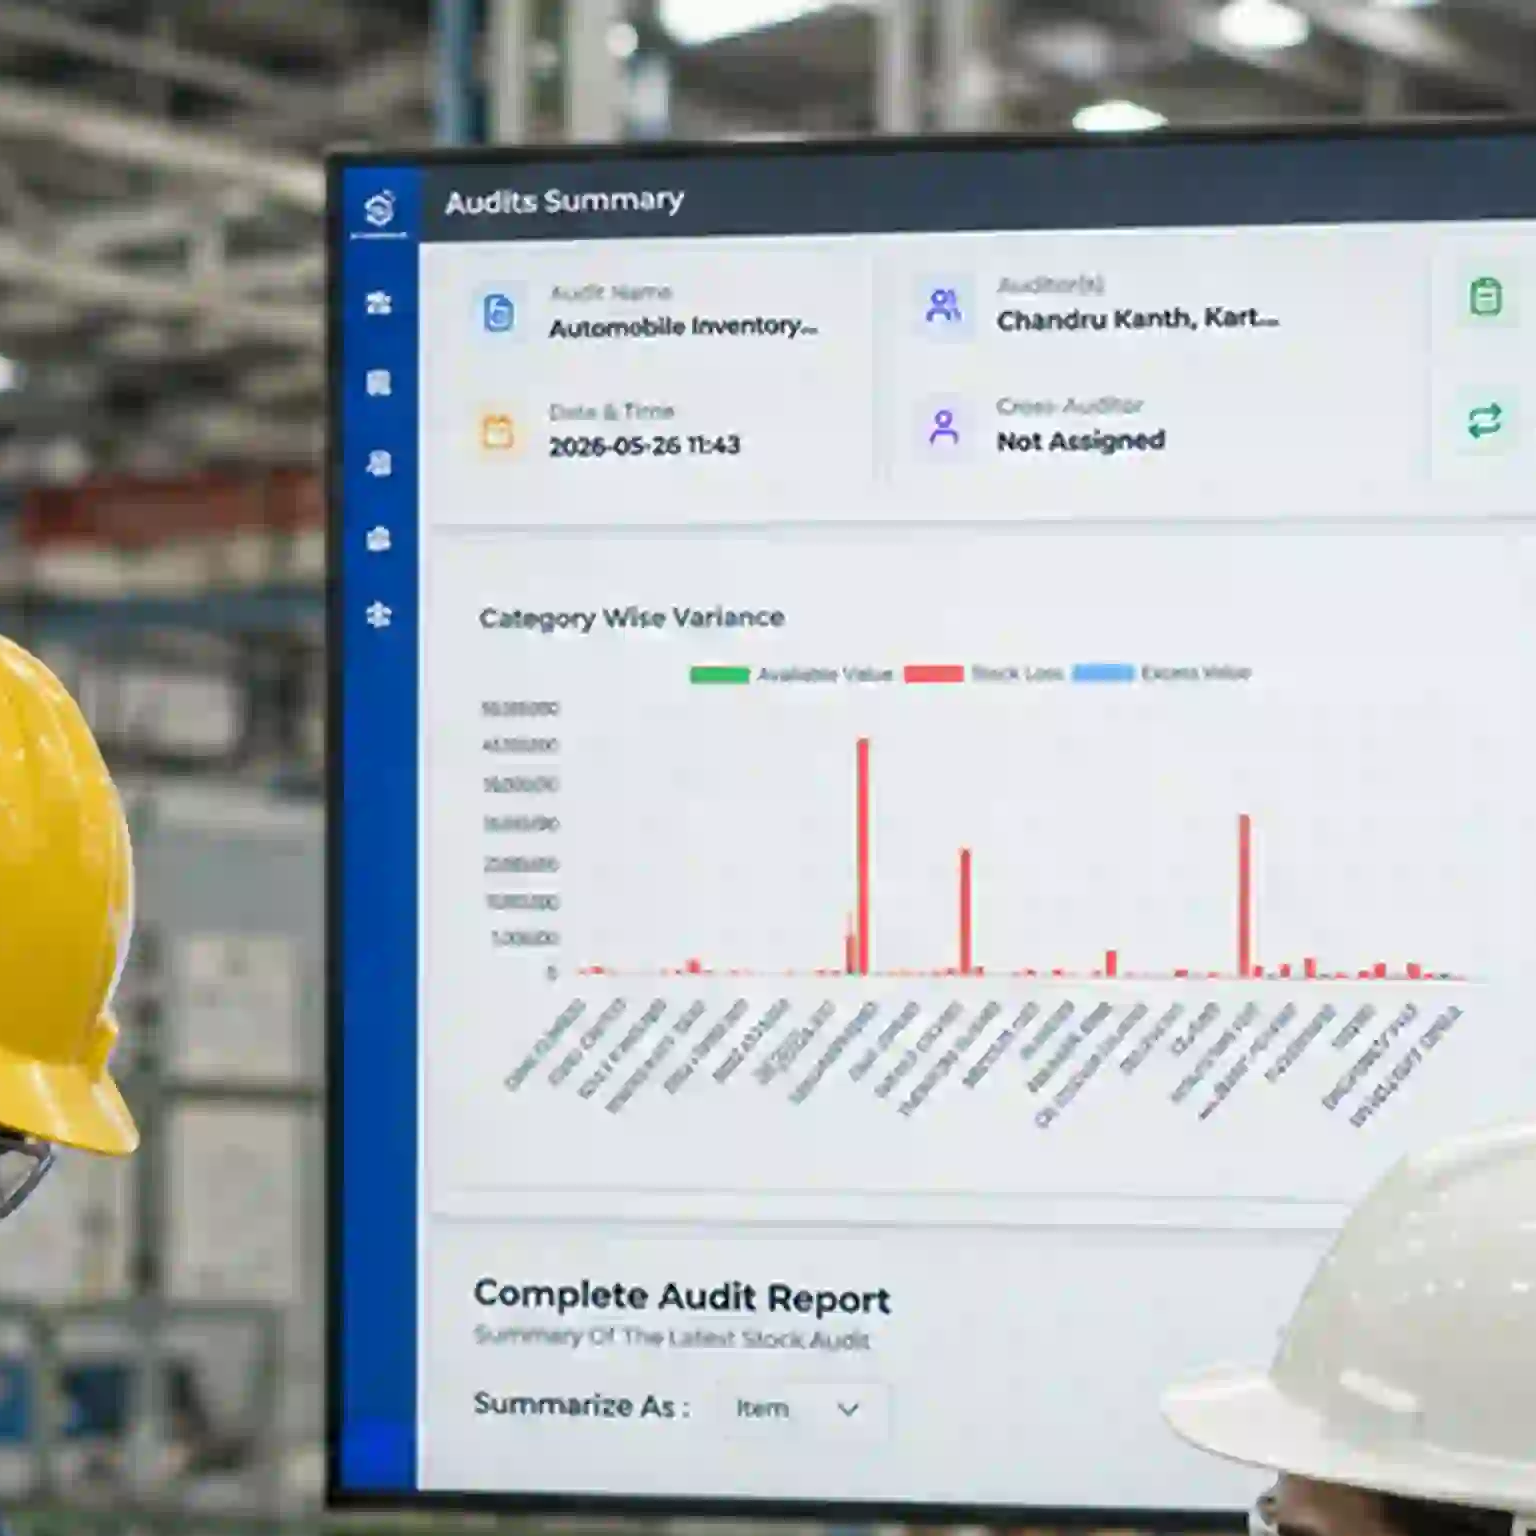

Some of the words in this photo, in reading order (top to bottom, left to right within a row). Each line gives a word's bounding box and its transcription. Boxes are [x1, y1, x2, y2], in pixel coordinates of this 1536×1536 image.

[445, 191, 539, 216] Audits
[544, 189, 686, 218] Summary
[549, 317, 688, 340] Automobile
[997, 309, 1109, 333] Chandru
[1115, 308, 1199, 332] Kanth,
[550, 436, 683, 459] 2026-05-26
[688, 435, 742, 456] 11:43
[998, 432, 1044, 454] Not
[1049, 429, 1167, 457] Assigned
[479, 608, 598, 635] Category
[603, 606, 668, 630] Wise
[673, 608, 787, 629] Variance
[475, 1279, 650, 1317] Complete
[659, 1281, 758, 1313] Audit
[769, 1284, 892, 1321] Report
[474, 1324, 585, 1350] Summary
[474, 1391, 635, 1419] Summarize
[641, 1395, 676, 1419] As
[738, 1400, 791, 1419] Item
